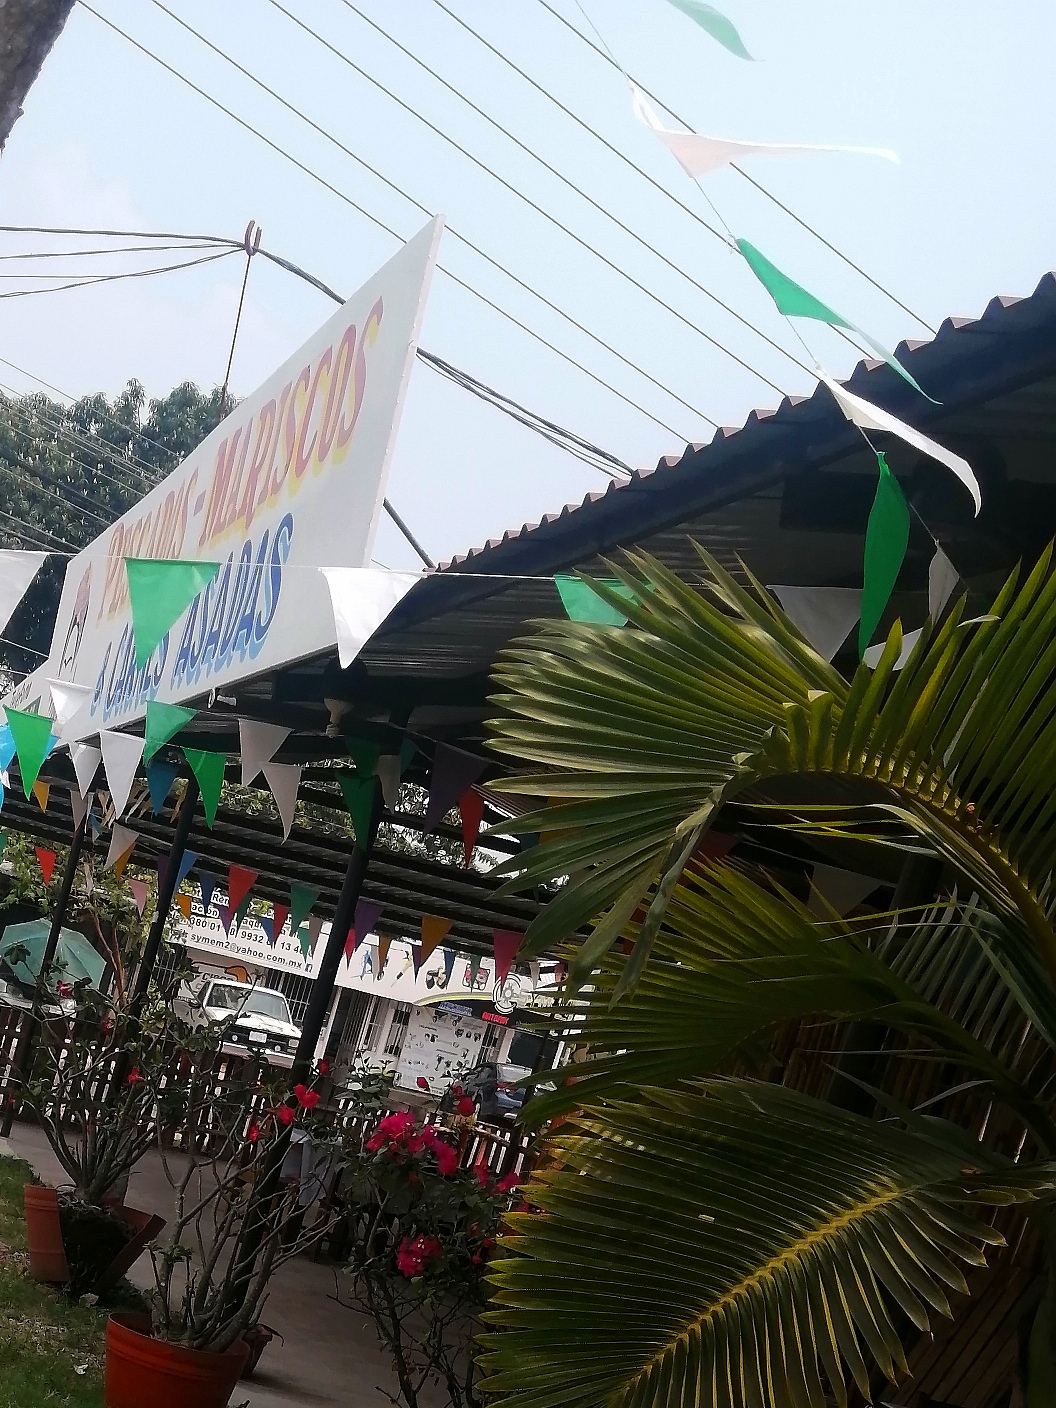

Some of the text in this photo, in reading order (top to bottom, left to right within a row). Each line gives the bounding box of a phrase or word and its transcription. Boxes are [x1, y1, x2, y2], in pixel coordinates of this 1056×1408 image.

[198, 296, 384, 550] MARISCOS
[173, 512, 294, 682] ASADAS
[241, 930, 264, 943] 9932
